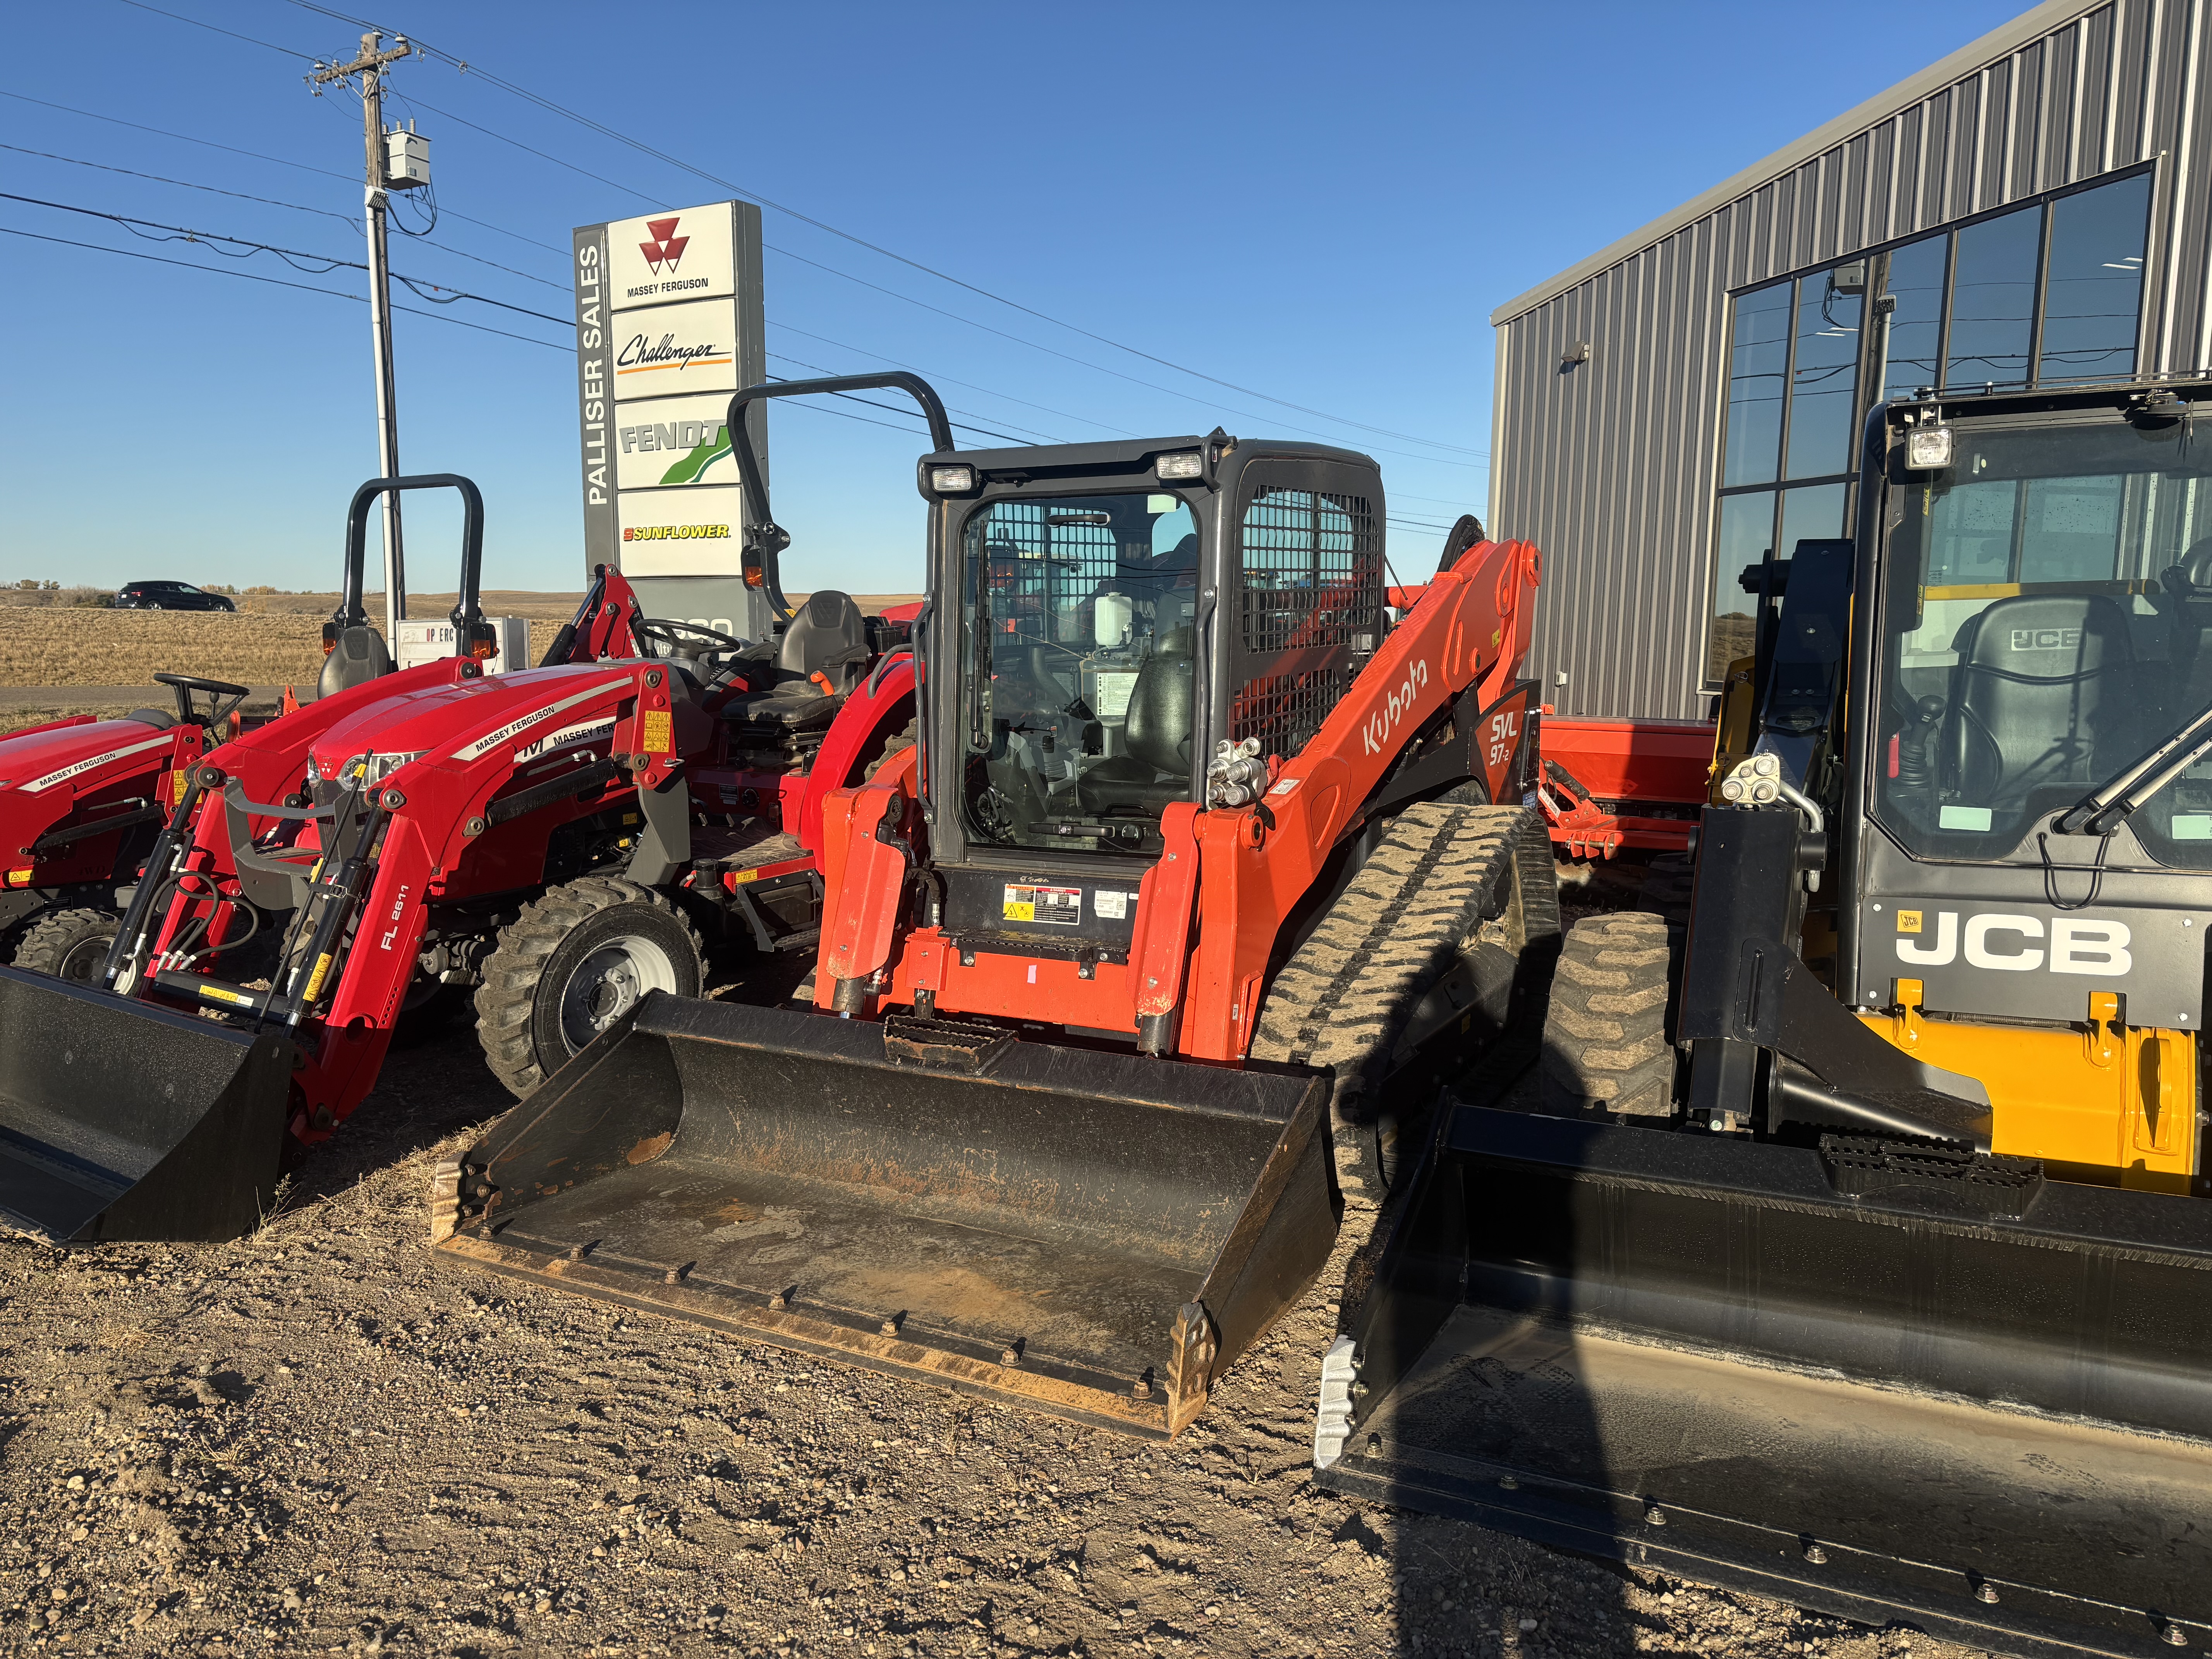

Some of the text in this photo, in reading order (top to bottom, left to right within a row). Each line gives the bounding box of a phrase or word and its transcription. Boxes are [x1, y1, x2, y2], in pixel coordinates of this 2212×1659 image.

[627, 278, 708, 298] MASSEY FERGUSON
[617, 333, 732, 371] Challenger
[579, 245, 607, 505] PALLISER SALES
[619, 419, 728, 453] FENDT
[634, 524, 729, 541] SUNFLOWER
[647, 618, 733, 639] GCO
[2014, 630, 2087, 649] JCB
[1363, 659, 1428, 756] Kubota
[476, 706, 555, 752] MASSEY FERGUSON
[553, 727, 593, 746] MASSEY
[1490, 711, 1517, 743] SVL
[40, 752, 116, 786] MASSEY FERGUSON
[380, 884, 409, 951] FL 2611
[1904, 916, 1917, 927] JCB
[1896, 911, 2132, 976] JCB
